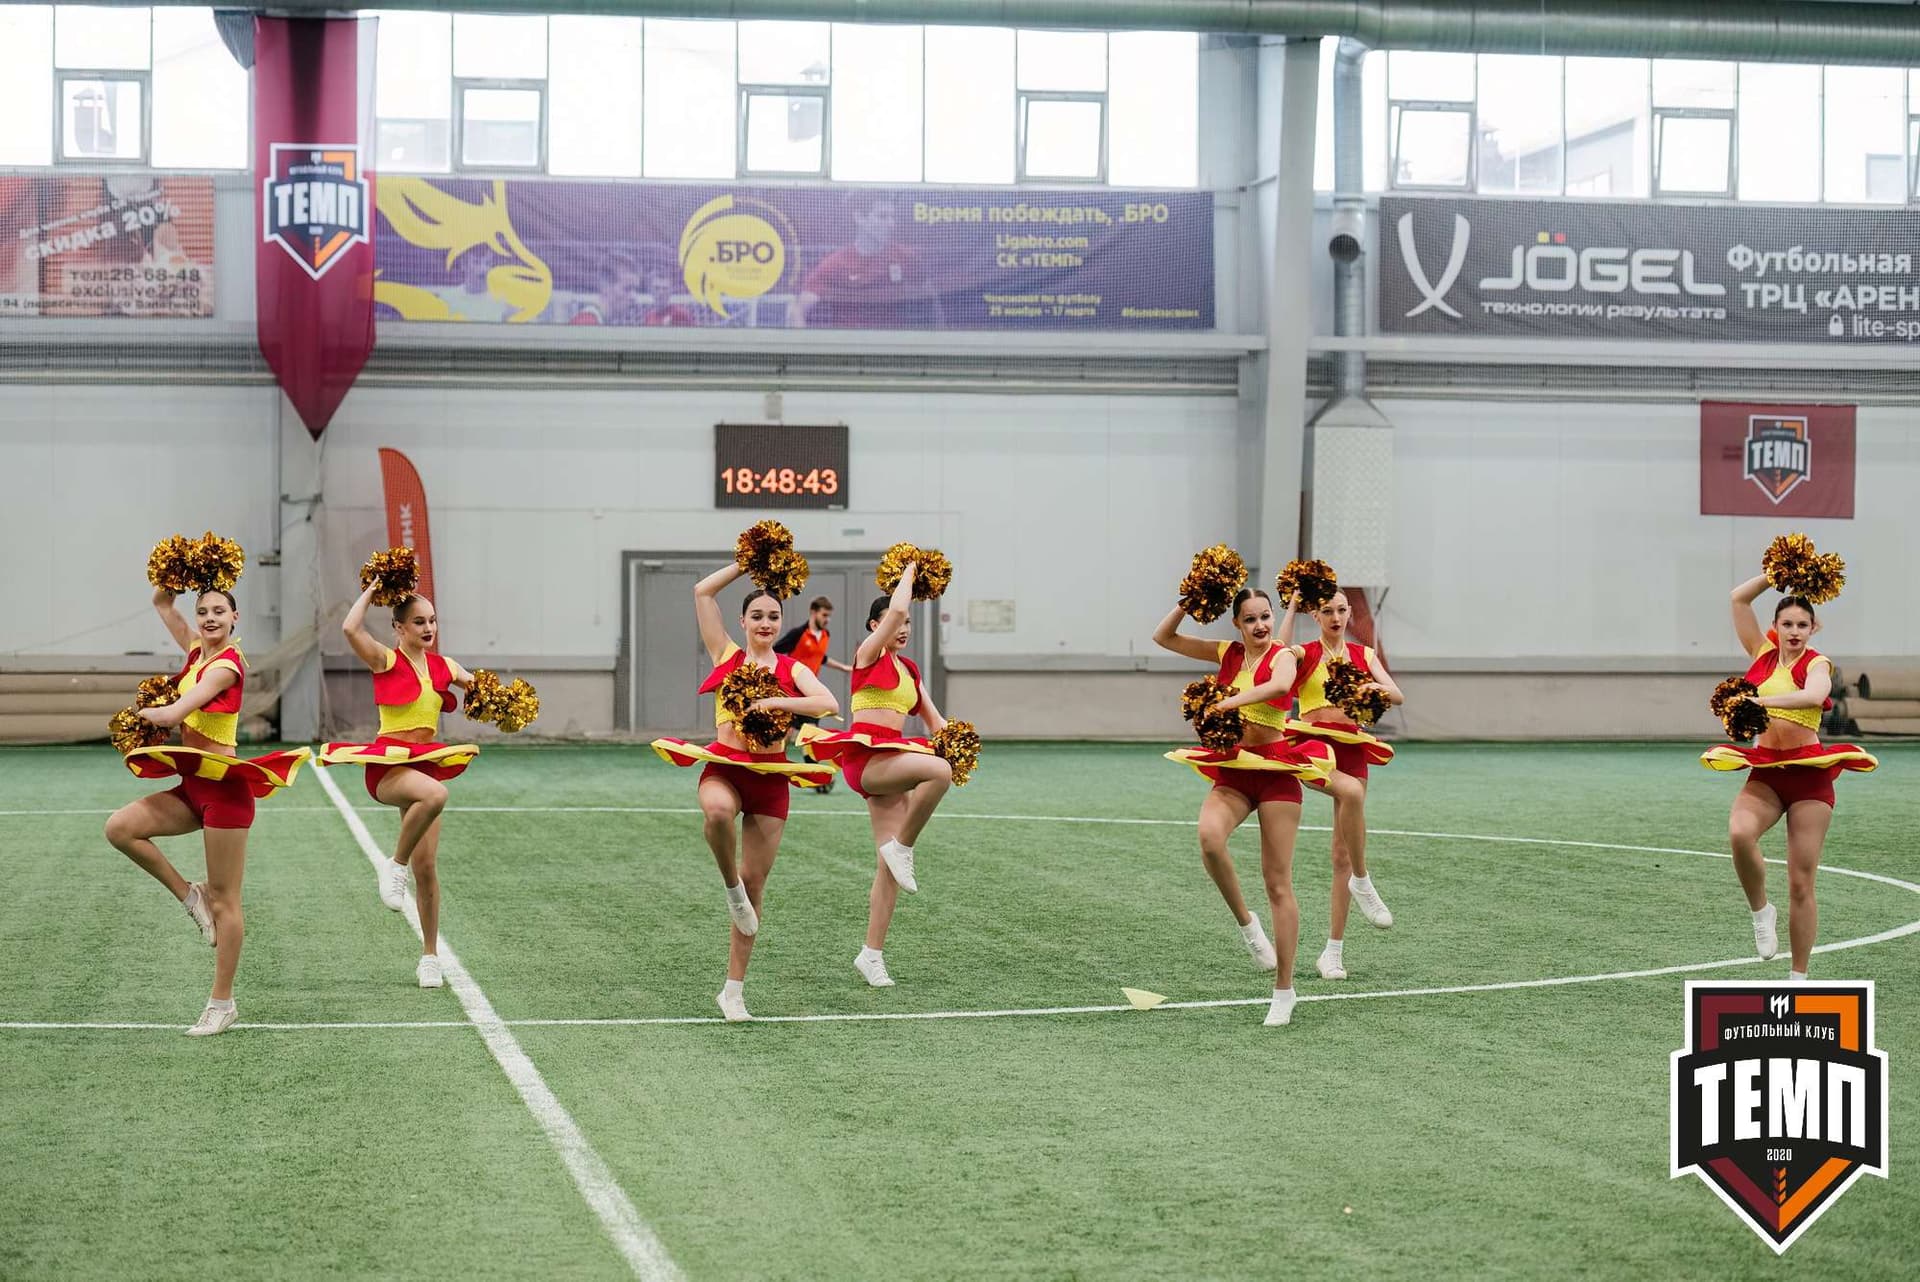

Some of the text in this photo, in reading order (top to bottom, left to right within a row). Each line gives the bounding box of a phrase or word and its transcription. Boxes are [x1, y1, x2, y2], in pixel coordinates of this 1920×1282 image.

[122, 200, 181, 232] 20%
[274, 181, 359, 228] ТЕМП
[914, 202, 1169, 226] Время побеждать, .БРО
[708, 241, 775, 264] .БРО
[995, 234, 1089, 251] Ligabro.com
[996, 253, 1085, 268] СК «ТЕМП»
[1479, 231, 1727, 295] JÖGEL
[1727, 243, 1912, 277] Футбольная
[1481, 301, 1727, 321] технологии результата
[1741, 282, 1920, 315] ТРЦ «АРЕН
[1751, 440, 1805, 472] ТЕМП
[721, 467, 838, 495] 18:48:43
